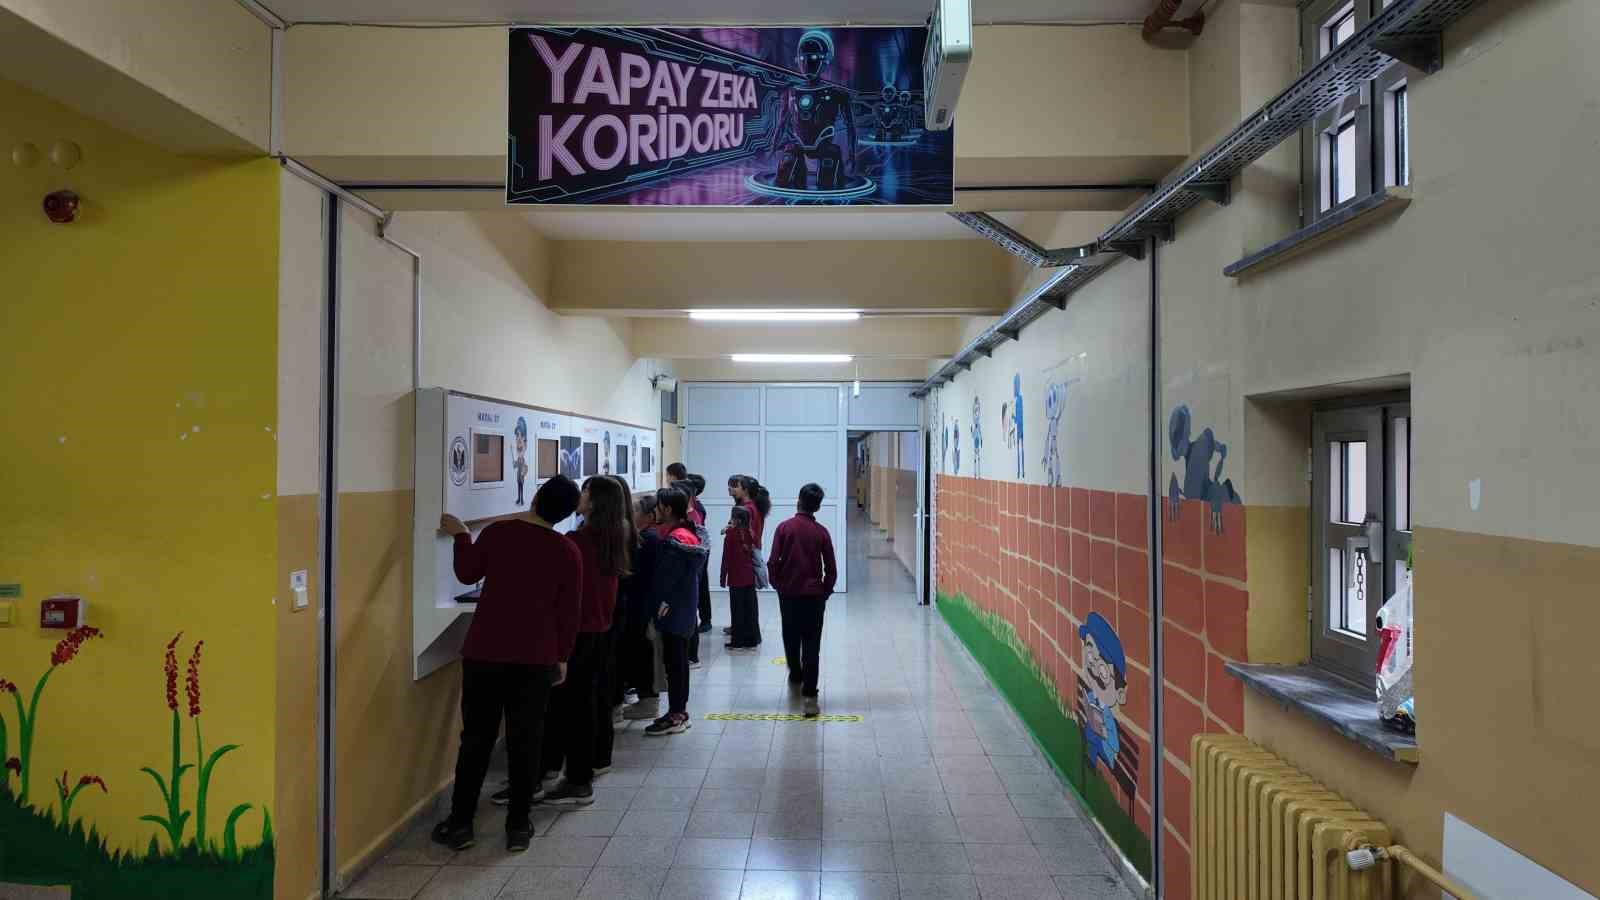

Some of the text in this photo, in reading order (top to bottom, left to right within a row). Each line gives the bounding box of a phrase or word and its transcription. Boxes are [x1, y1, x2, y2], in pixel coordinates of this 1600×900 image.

[528, 33, 757, 109] YAPAY ZEKA
[538, 105, 743, 181] KORİDORU
